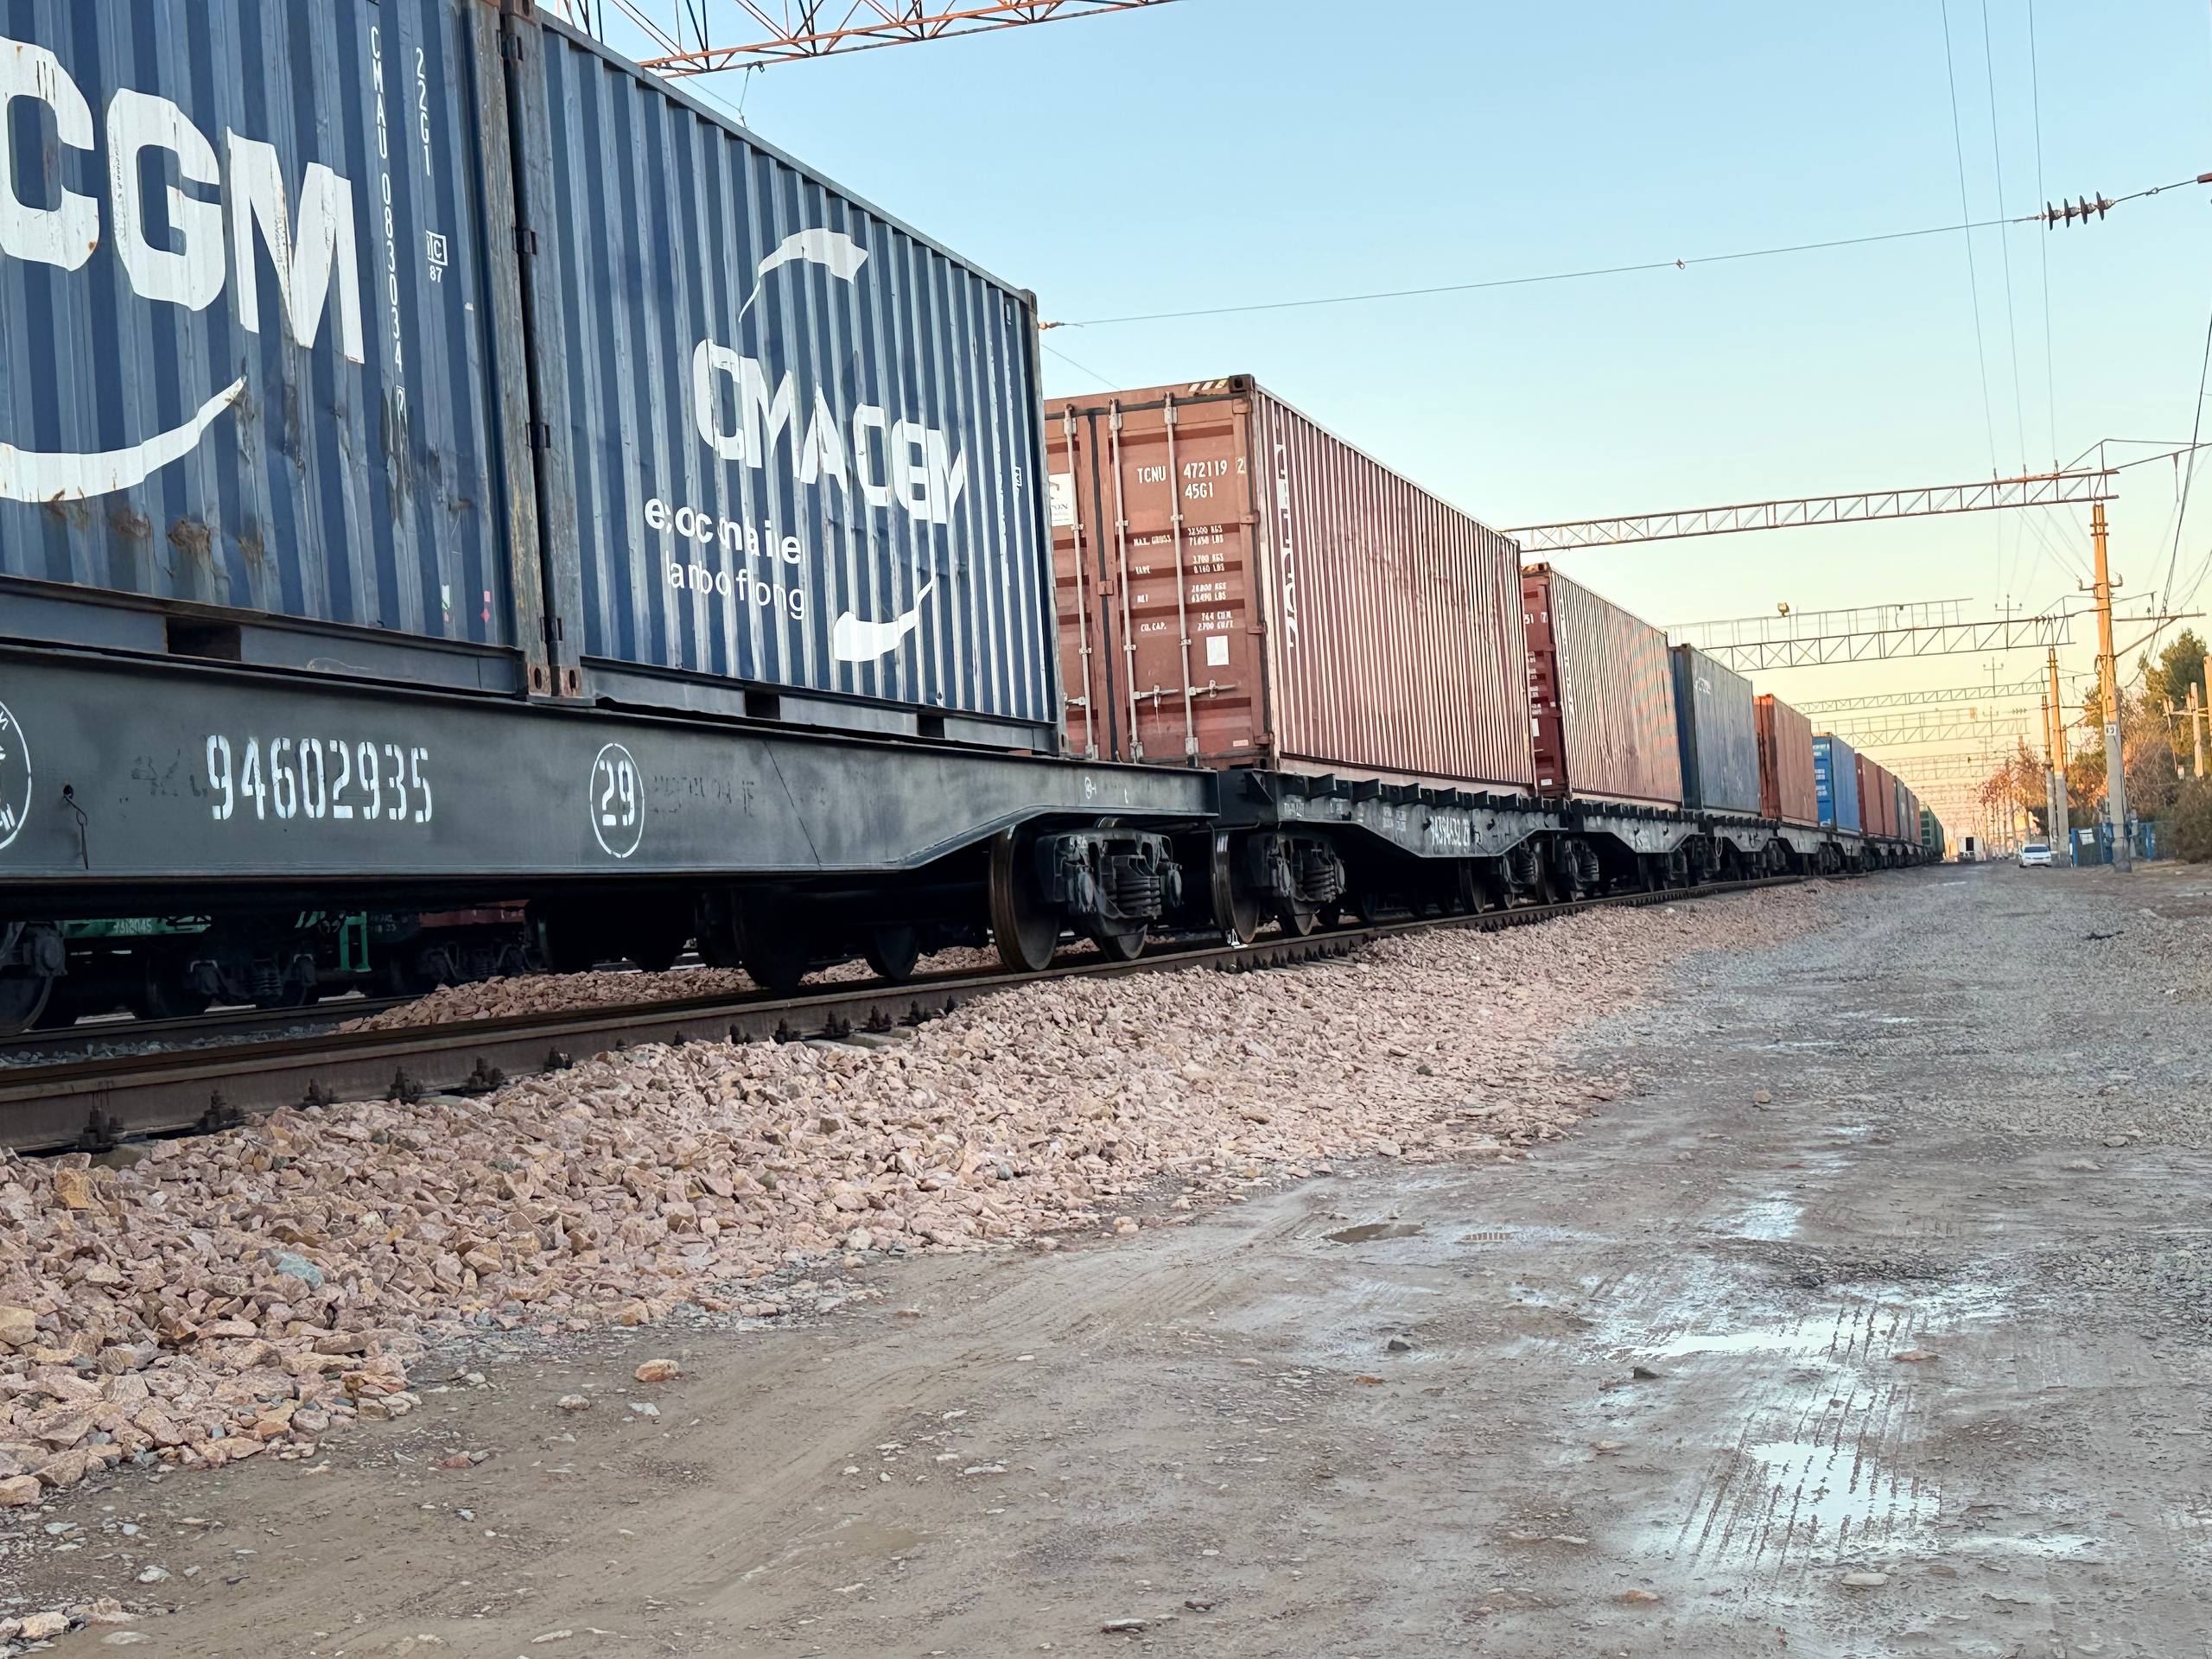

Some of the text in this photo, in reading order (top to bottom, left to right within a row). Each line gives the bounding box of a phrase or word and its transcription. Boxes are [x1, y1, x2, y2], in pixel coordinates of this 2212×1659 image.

[416, 47, 429, 176] 22G1
[0, 35, 365, 364] CGM
[371, 26, 387, 159] CMAU
[381, 172, 403, 373] 083034
[429, 264, 442, 283] 87
[692, 339, 849, 493] CMA
[1137, 458, 1245, 484] TCNU 472119 2
[1185, 481, 1214, 499] 45G1
[206, 734, 433, 823] 94602935
[599, 760, 635, 826] 29
